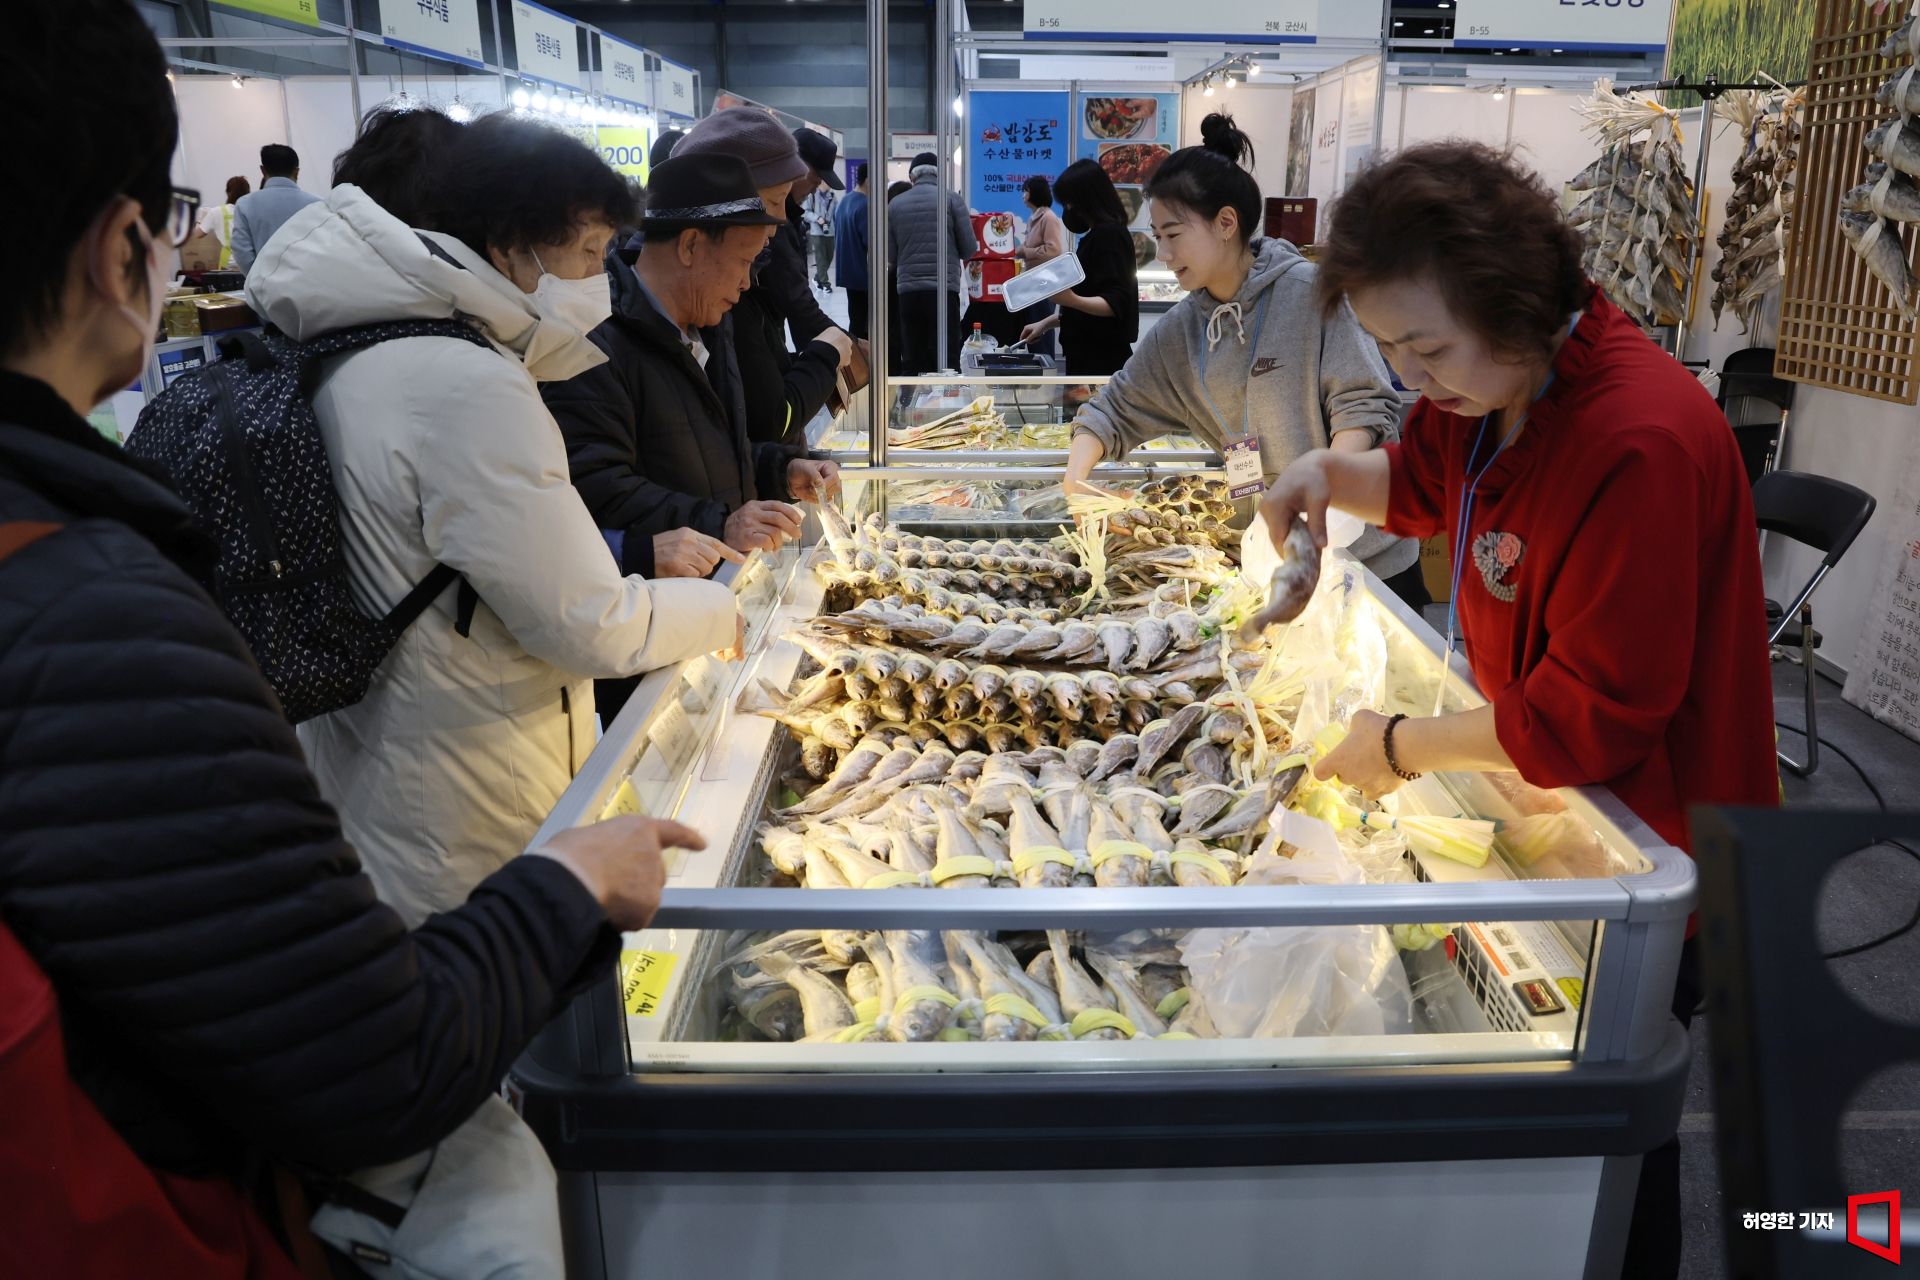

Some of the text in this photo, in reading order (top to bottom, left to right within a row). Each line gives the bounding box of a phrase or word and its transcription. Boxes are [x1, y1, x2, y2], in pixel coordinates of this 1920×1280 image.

[1039, 18, 1060, 27] B-56
[1265, 21, 1307, 32] 전북 군산시
[1470, 26, 1490, 36] B-55
[983, 147, 1053, 161] 수산물마켓
[983, 174, 1004, 183] 100%
[1255, 357, 1278, 369] NIKE
[1234, 484, 1260, 498] EXHIBITOR
